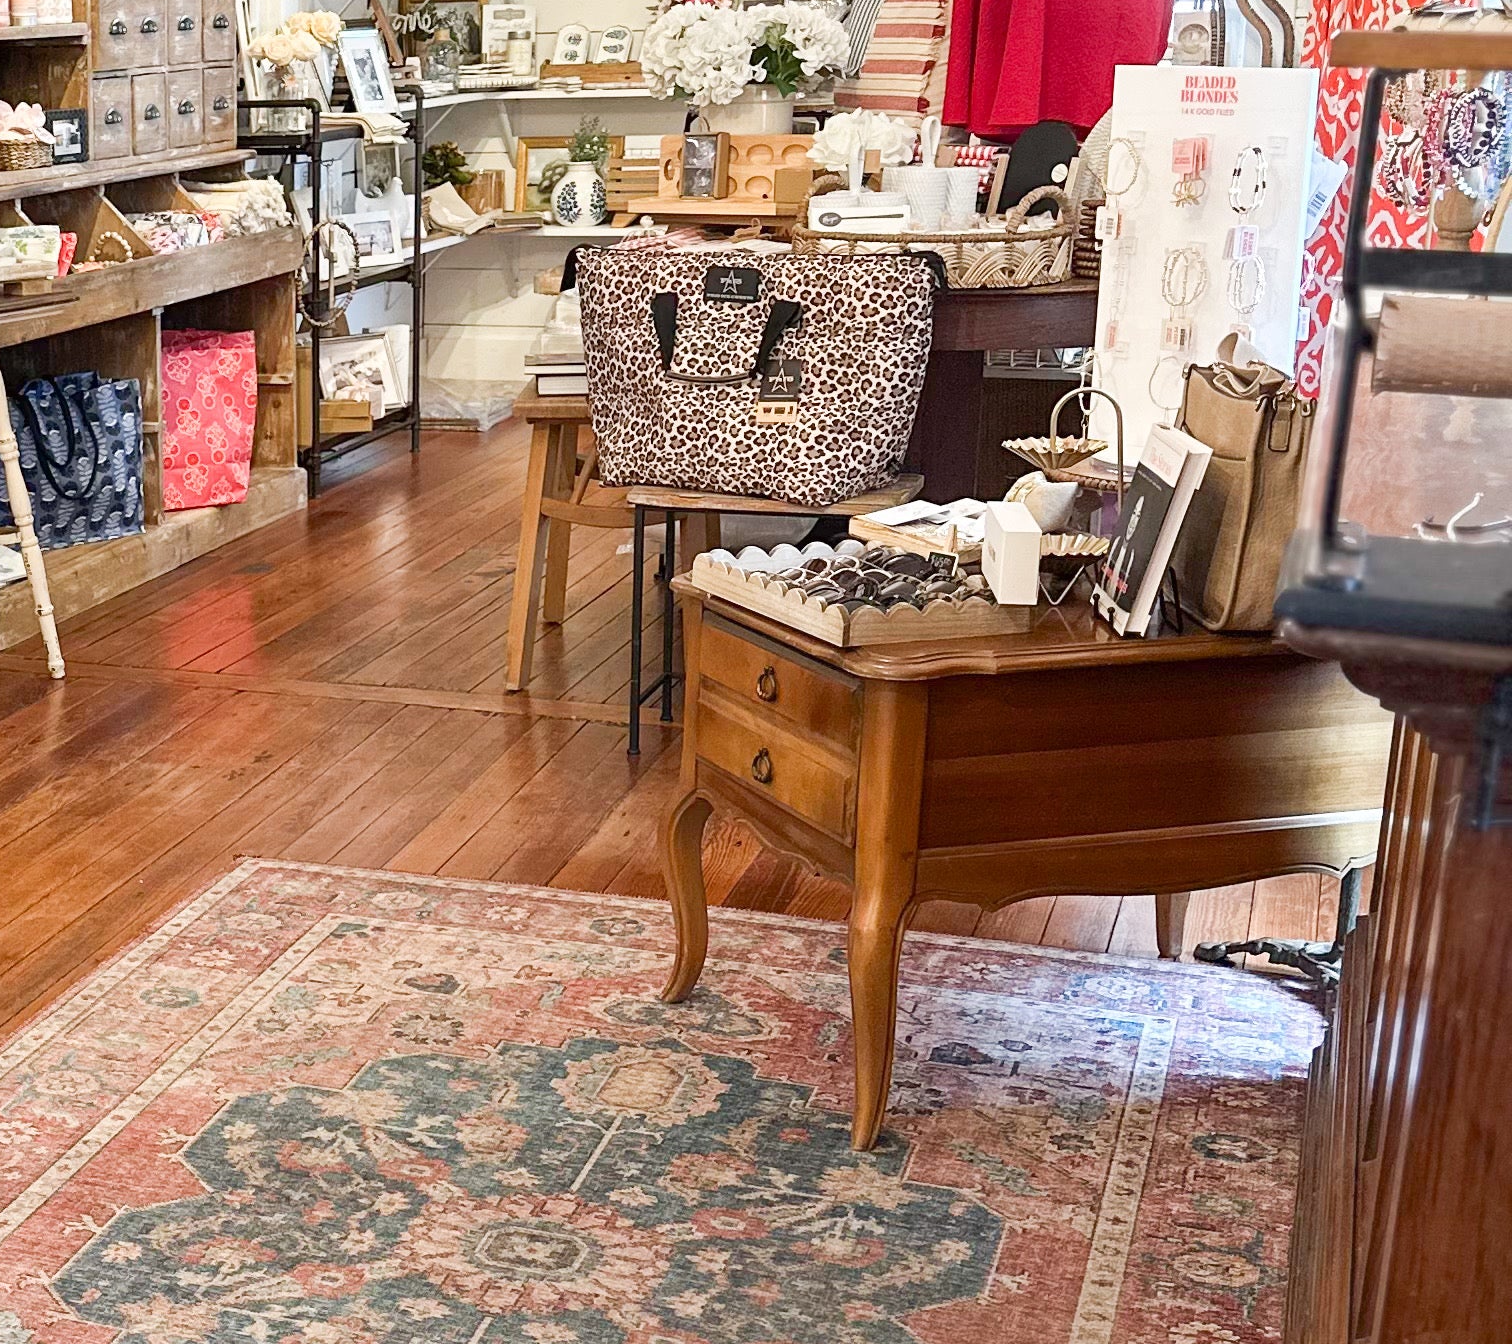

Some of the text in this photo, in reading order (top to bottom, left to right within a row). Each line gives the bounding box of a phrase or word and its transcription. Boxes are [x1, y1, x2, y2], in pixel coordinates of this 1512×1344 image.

[1185, 75, 1237, 89] BEADED
[1180, 89, 1239, 104] BLONDES
[1195, 108, 1215, 116] GOLD
[1216, 109, 1235, 117] FILLED
